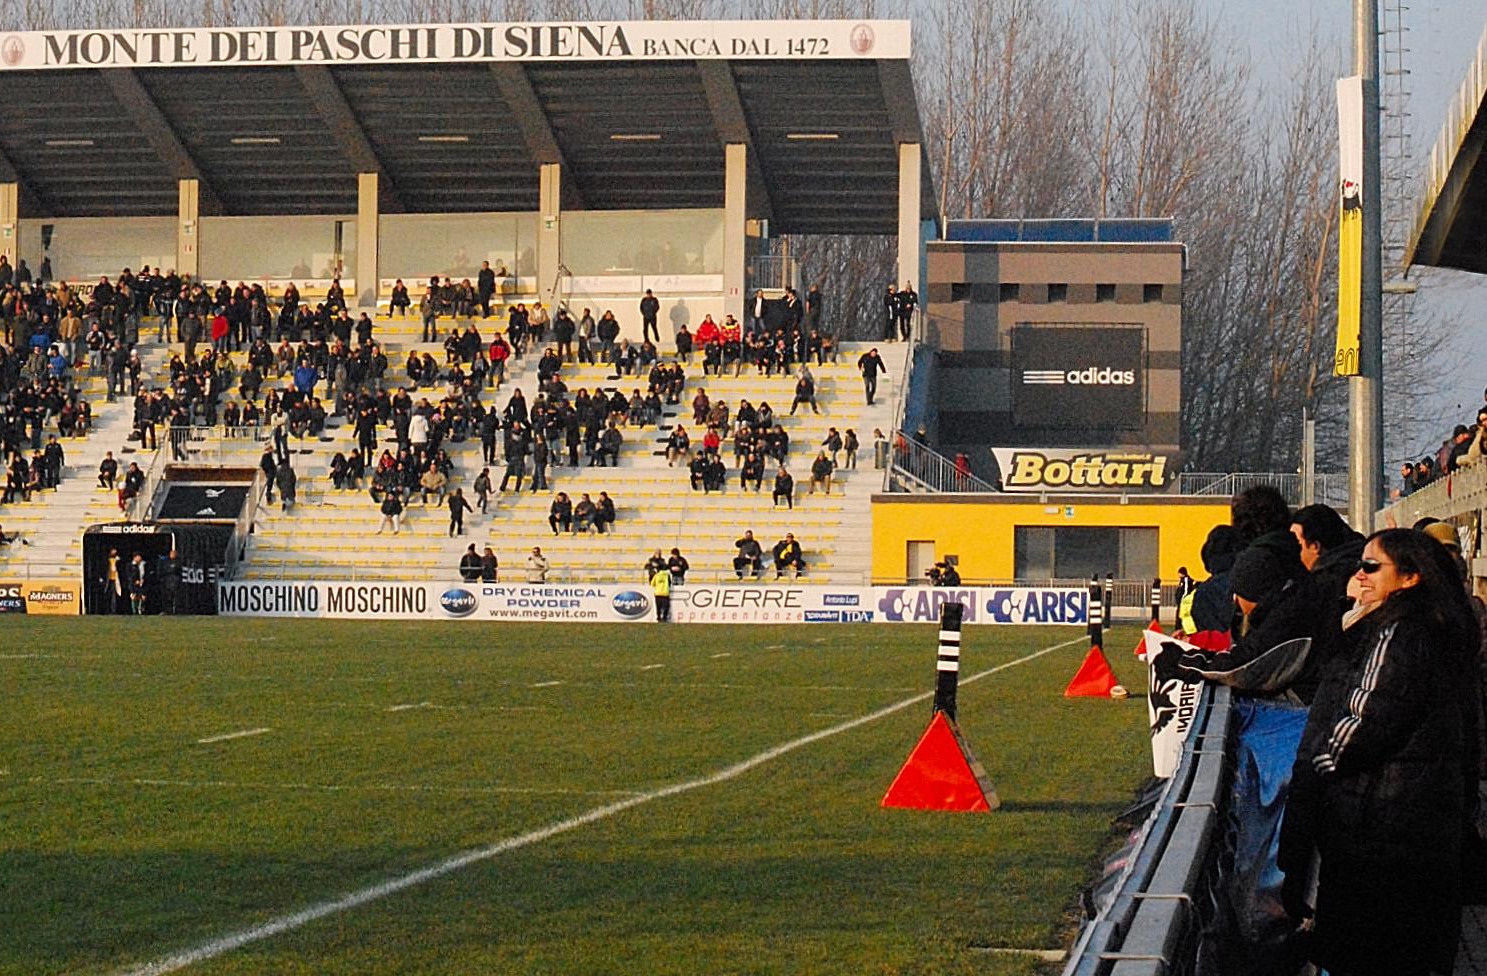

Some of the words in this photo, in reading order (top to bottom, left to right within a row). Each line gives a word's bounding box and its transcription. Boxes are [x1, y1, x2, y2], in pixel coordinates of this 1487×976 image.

[42, 31, 198, 65] MONTE
[208, 30, 279, 63] DEI
[289, 27, 439, 61] PASCHI
[452, 26, 495, 58] DI
[503, 24, 633, 57] SIENA
[642, 37, 722, 56] BANCA
[730, 37, 778, 56] DAL
[786, 37, 830, 56] 1472
[1066, 366, 1136, 385] adidas
[1007, 452, 1167, 487] Bottari
[122, 523, 156, 534] adidas
[29, 591, 73, 601] MAGNERS
[219, 584, 319, 613] MOSCHINO
[326, 586, 427, 613] MOSCHINO
[482, 587, 516, 597] DRY
[520, 587, 606, 598] CHEMICAL
[669, 589, 804, 608] RGIERRE
[507, 598, 581, 608] POWDER
[1023, 590, 1088, 624] ARISI
[489, 608, 599, 620] www.megavit.com
[667, 610, 804, 623] appresentanze
